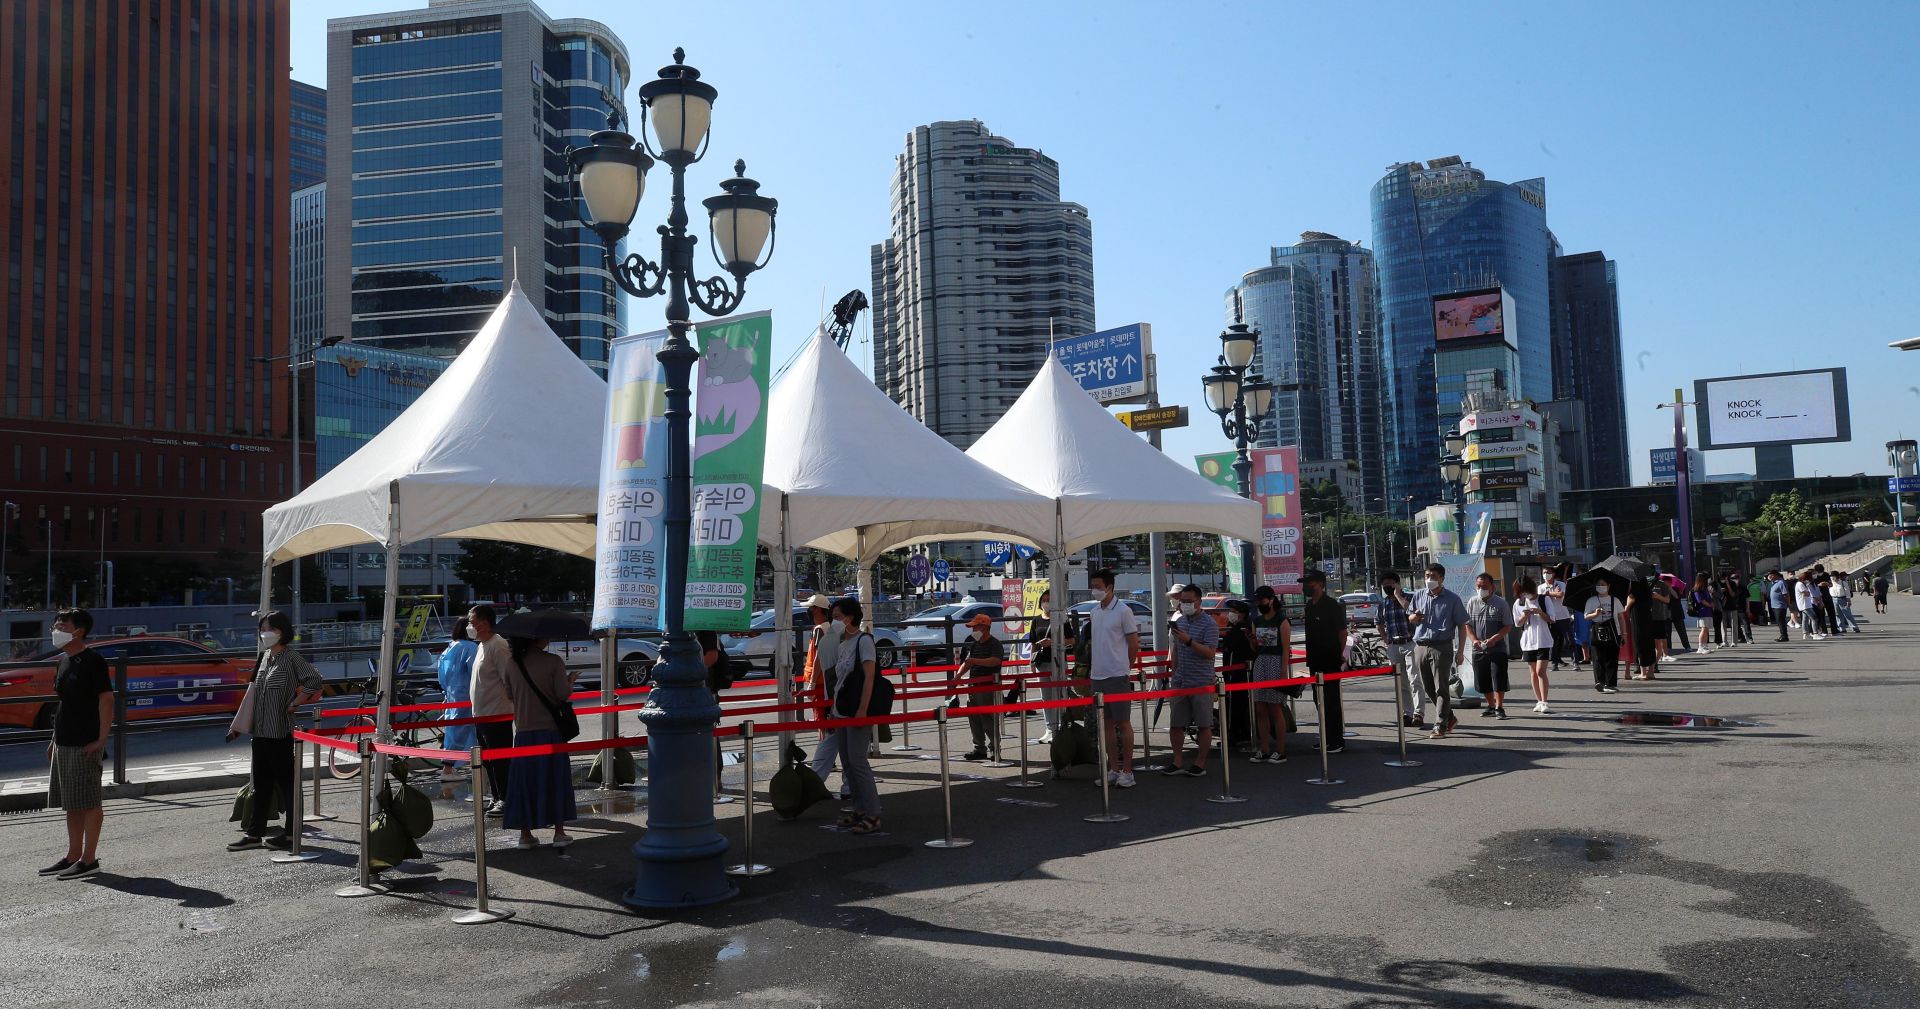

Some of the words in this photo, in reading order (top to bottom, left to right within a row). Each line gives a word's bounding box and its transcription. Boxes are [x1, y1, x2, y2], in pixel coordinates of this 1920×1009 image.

[1076, 338, 1105, 353] 롯데아울렛
[1110, 332, 1136, 345] 롯데마트
[1072, 356, 1119, 384] 주차장
[1101, 388, 1113, 398] 전용
[1114, 385, 1133, 397] 진입로
[1727, 399, 1762, 409] KNOCK
[1728, 409, 1762, 419] KNOCK
[984, 541, 1011, 555] 택시승차
[910, 559, 926, 568] 택시
[911, 569, 927, 579] 하차
[1003, 584, 1021, 593] 서울역
[1003, 593, 1021, 603] 주차장
[177, 678, 222, 702] UT
